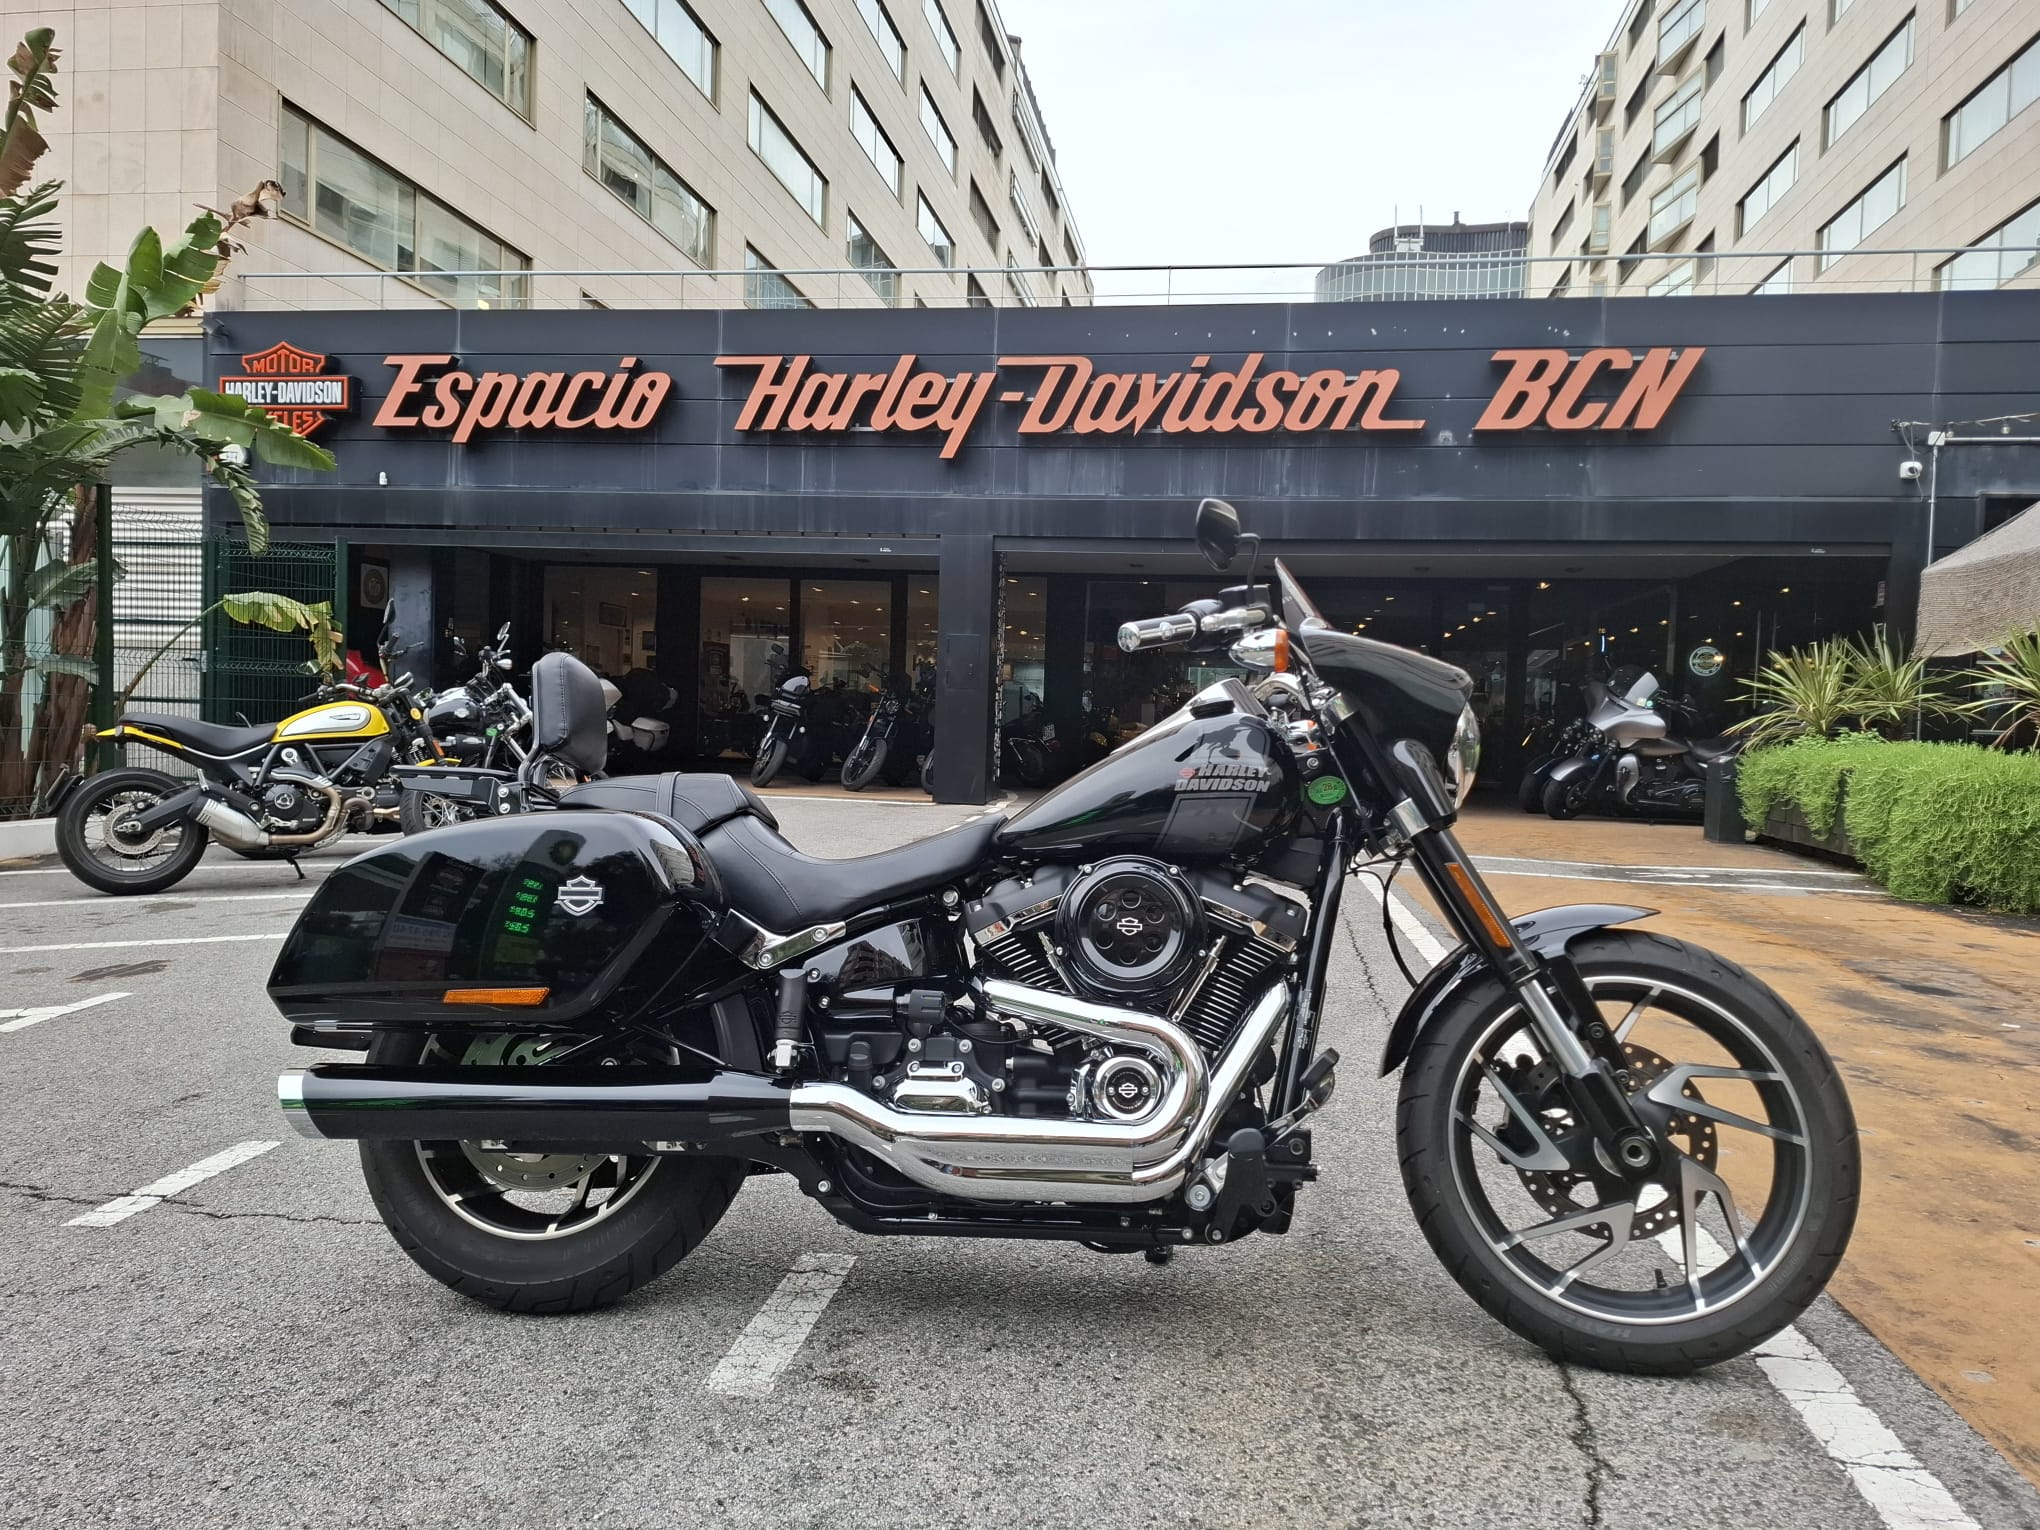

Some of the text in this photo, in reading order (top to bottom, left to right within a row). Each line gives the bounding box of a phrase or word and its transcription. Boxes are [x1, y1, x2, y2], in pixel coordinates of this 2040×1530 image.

[252, 350, 314, 373] MOTOR
[225, 381, 342, 403] HARLEY-DAVIDSON
[372, 347, 1706, 459] Espacio Harley-Davidson BCN
[1174, 778, 1270, 792] DAVIDSON
